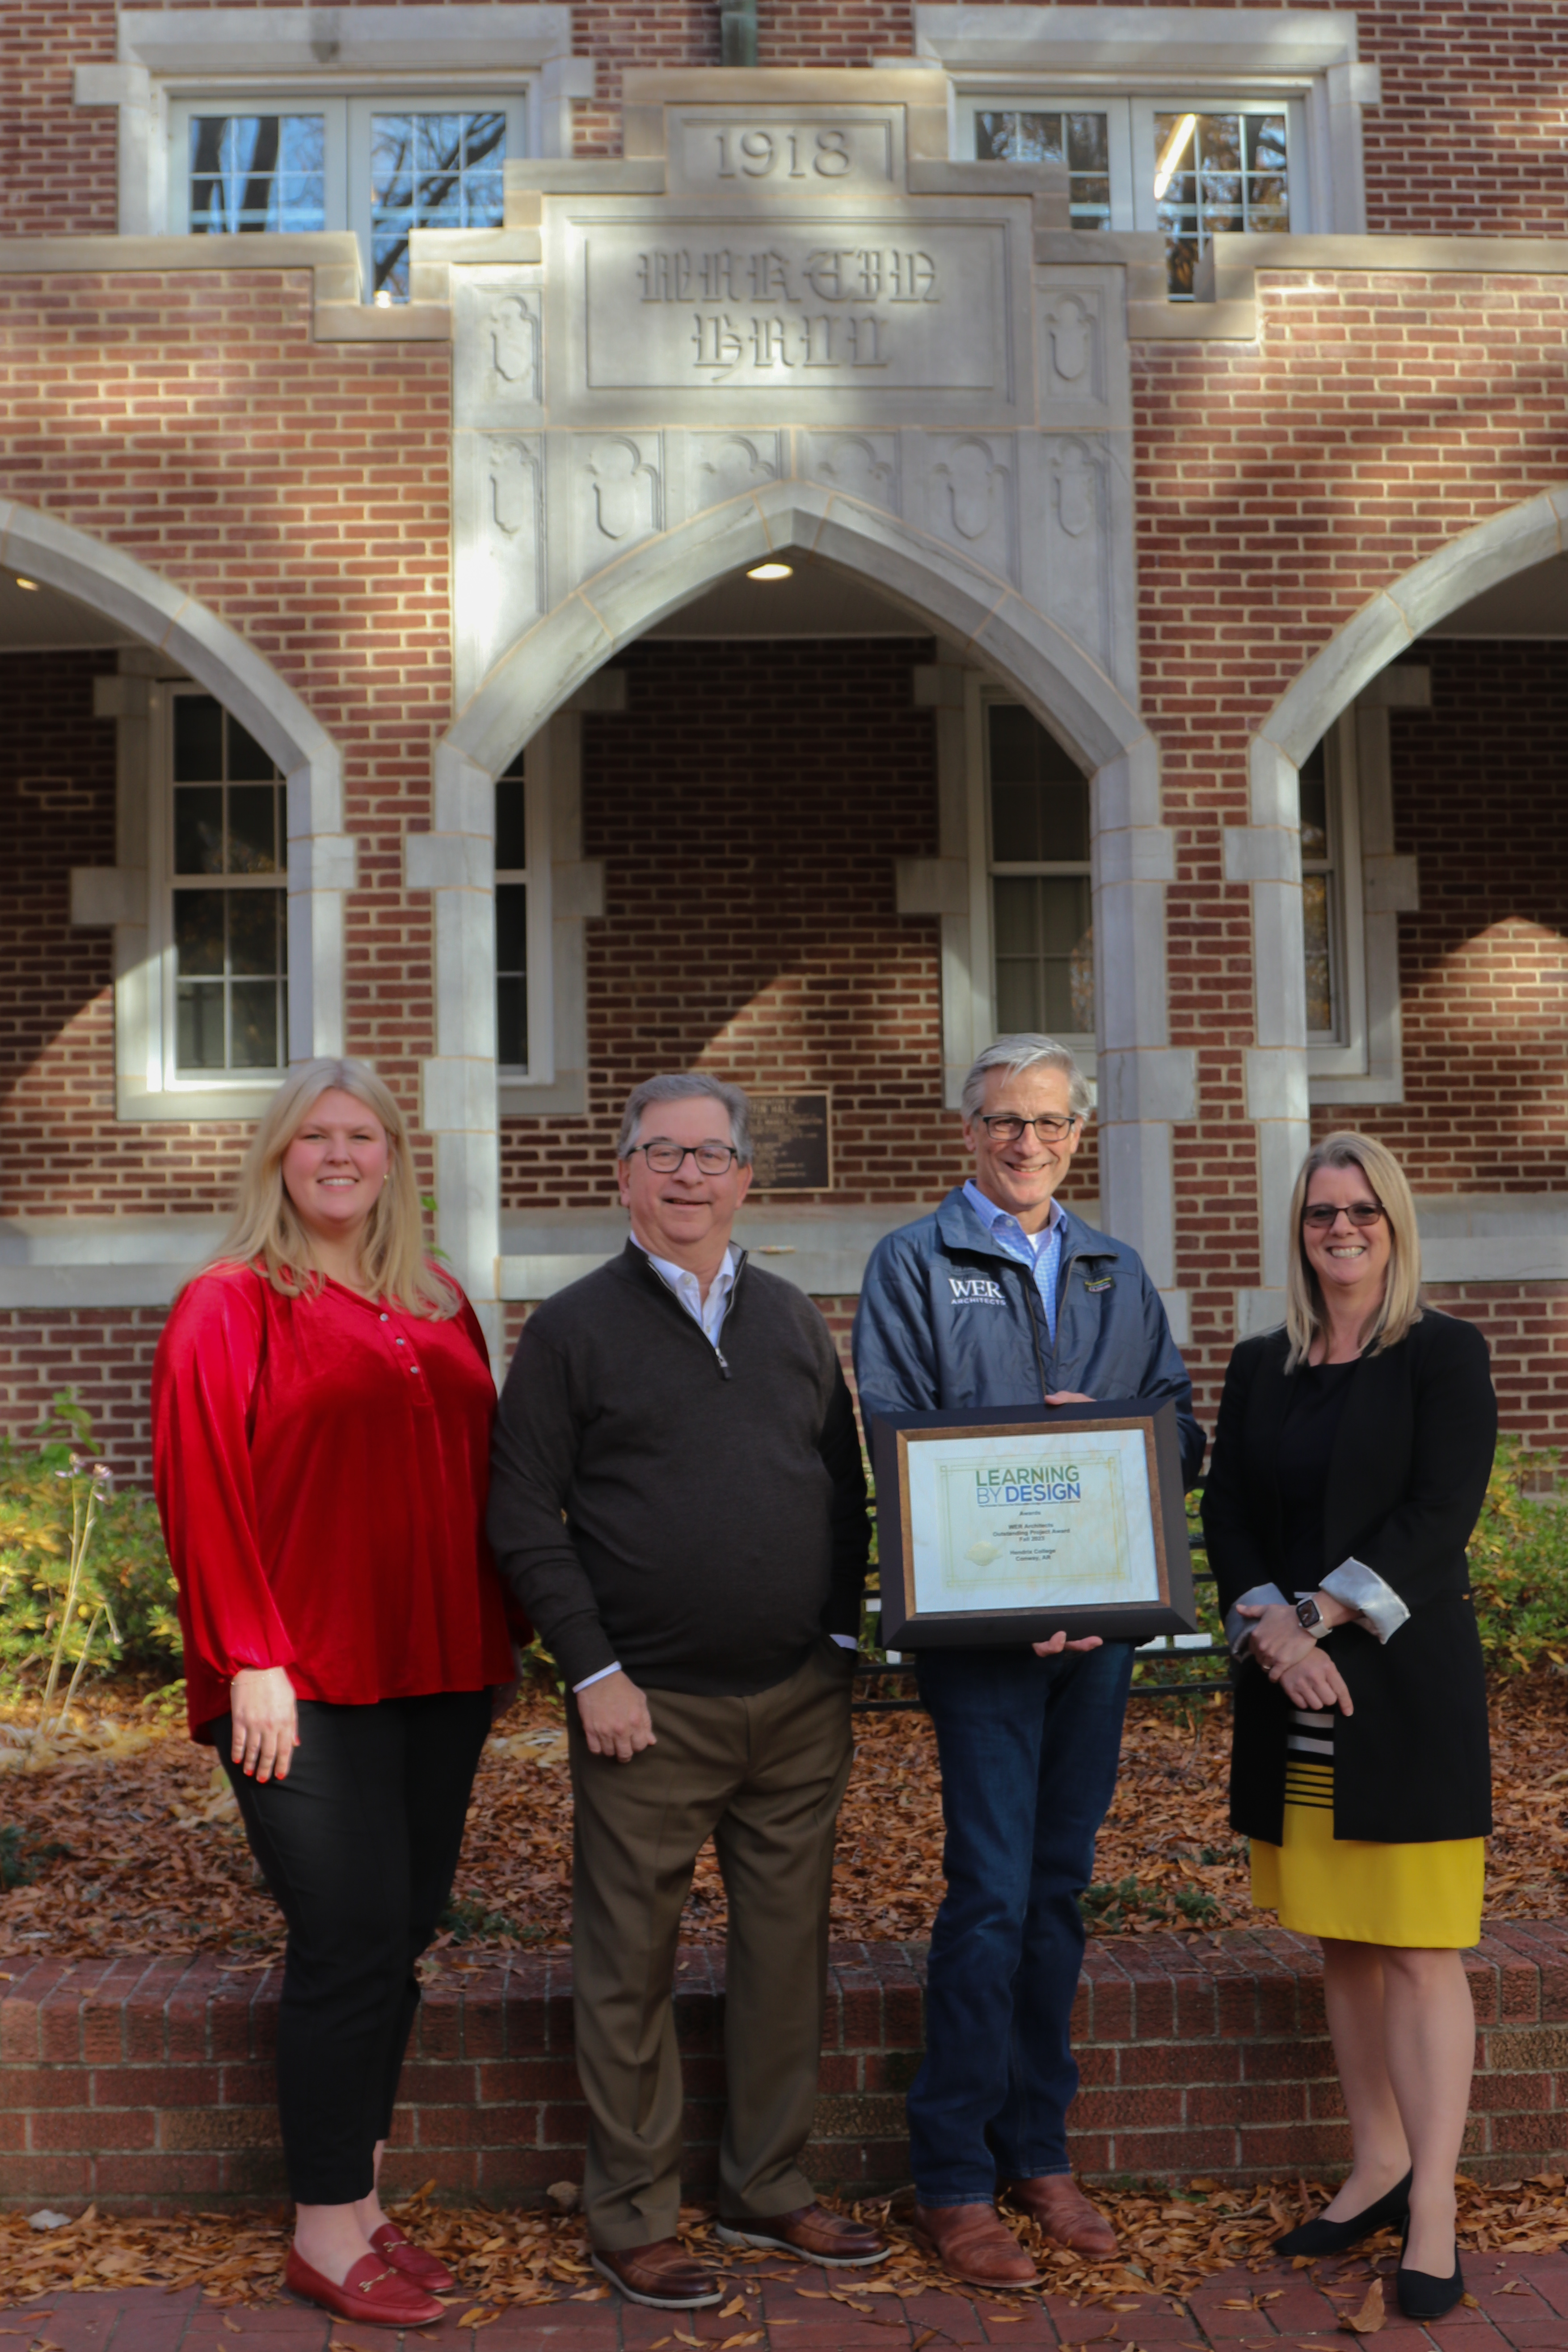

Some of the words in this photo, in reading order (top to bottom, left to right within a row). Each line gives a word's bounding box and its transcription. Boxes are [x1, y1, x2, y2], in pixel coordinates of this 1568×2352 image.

[716, 130, 851, 178] 1918
[636, 249, 940, 303] MARTIN
[691, 313, 889, 380] HALL
[948, 1278, 1006, 1298] WER
[951, 1298, 1006, 1306] ARCHITECTS
[976, 1466, 1079, 1486] LEARNING
[977, 1486, 1002, 1505] BY
[1005, 1482, 1081, 1503] DESIGN
